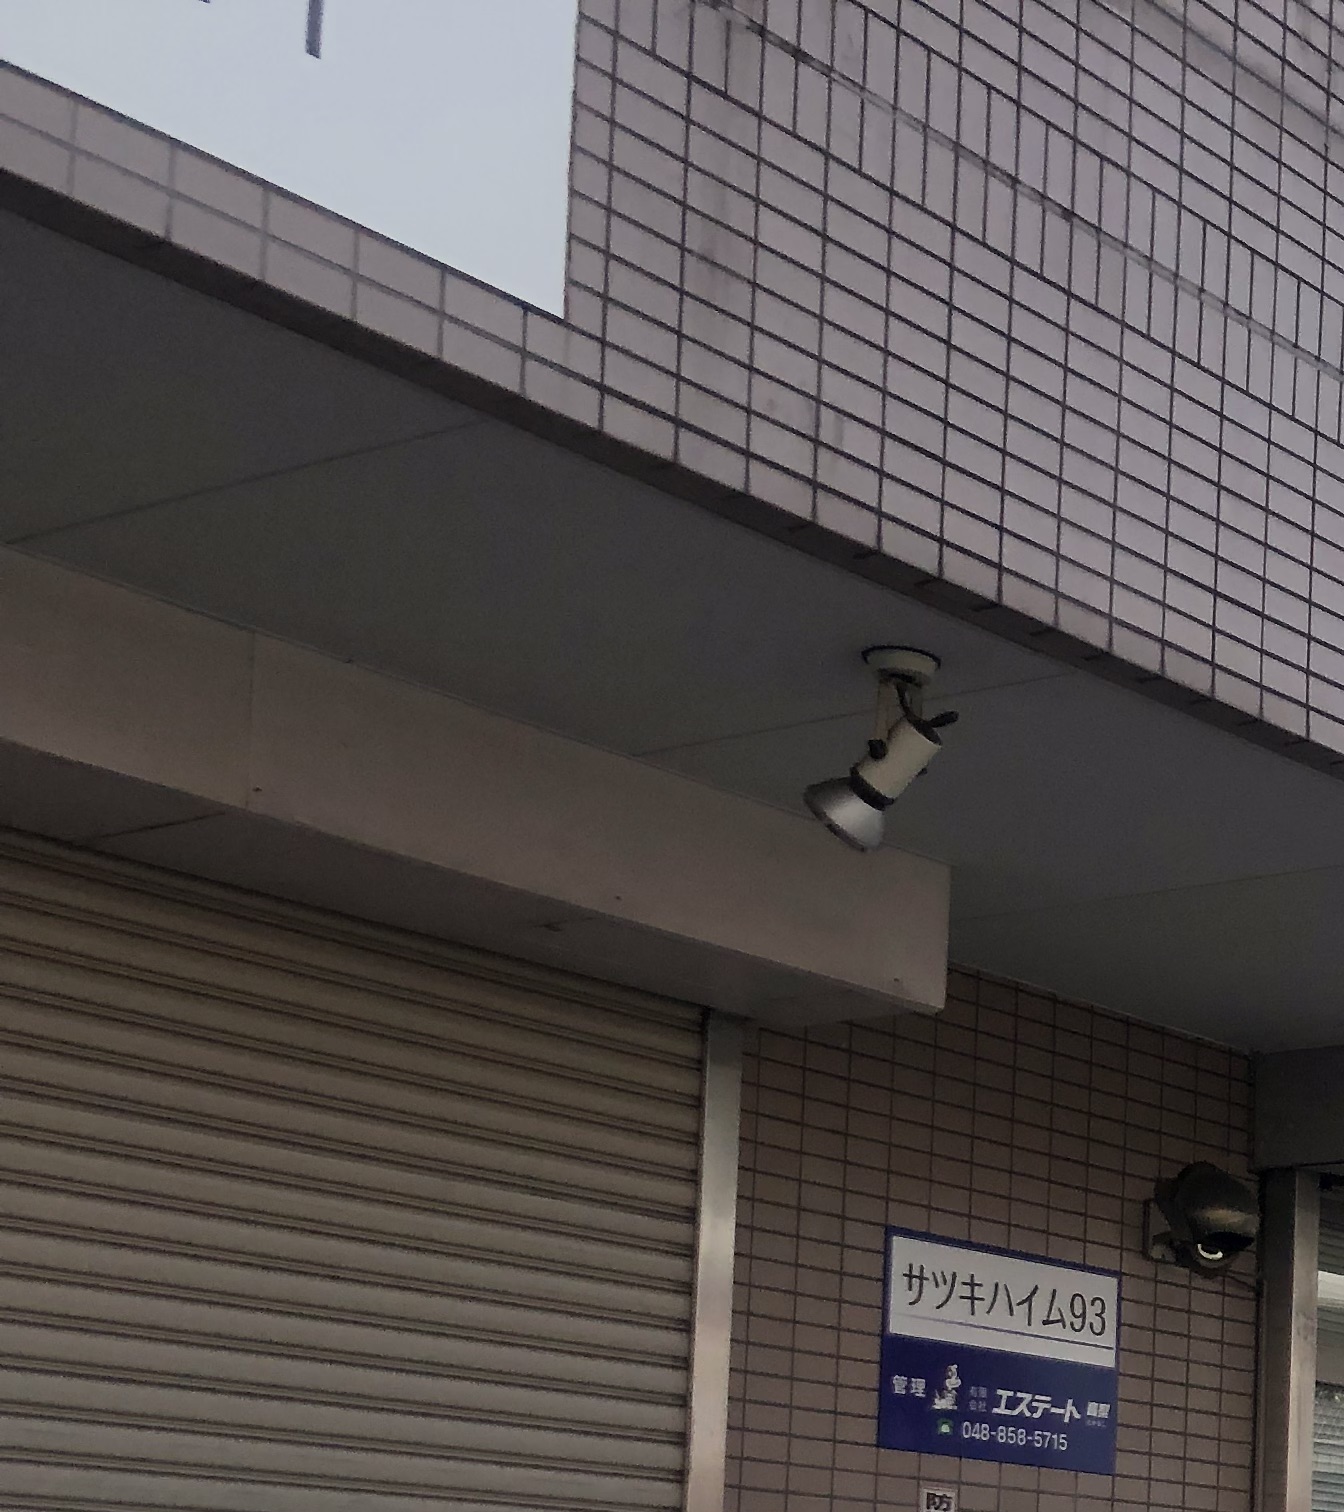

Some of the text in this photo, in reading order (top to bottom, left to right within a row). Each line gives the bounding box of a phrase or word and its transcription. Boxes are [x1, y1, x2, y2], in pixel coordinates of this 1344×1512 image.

[902, 1263, 1107, 1336] サツキハイム93
[992, 1388, 1081, 1422] エステート
[962, 1421, 1068, 1450] 048-858-5715
